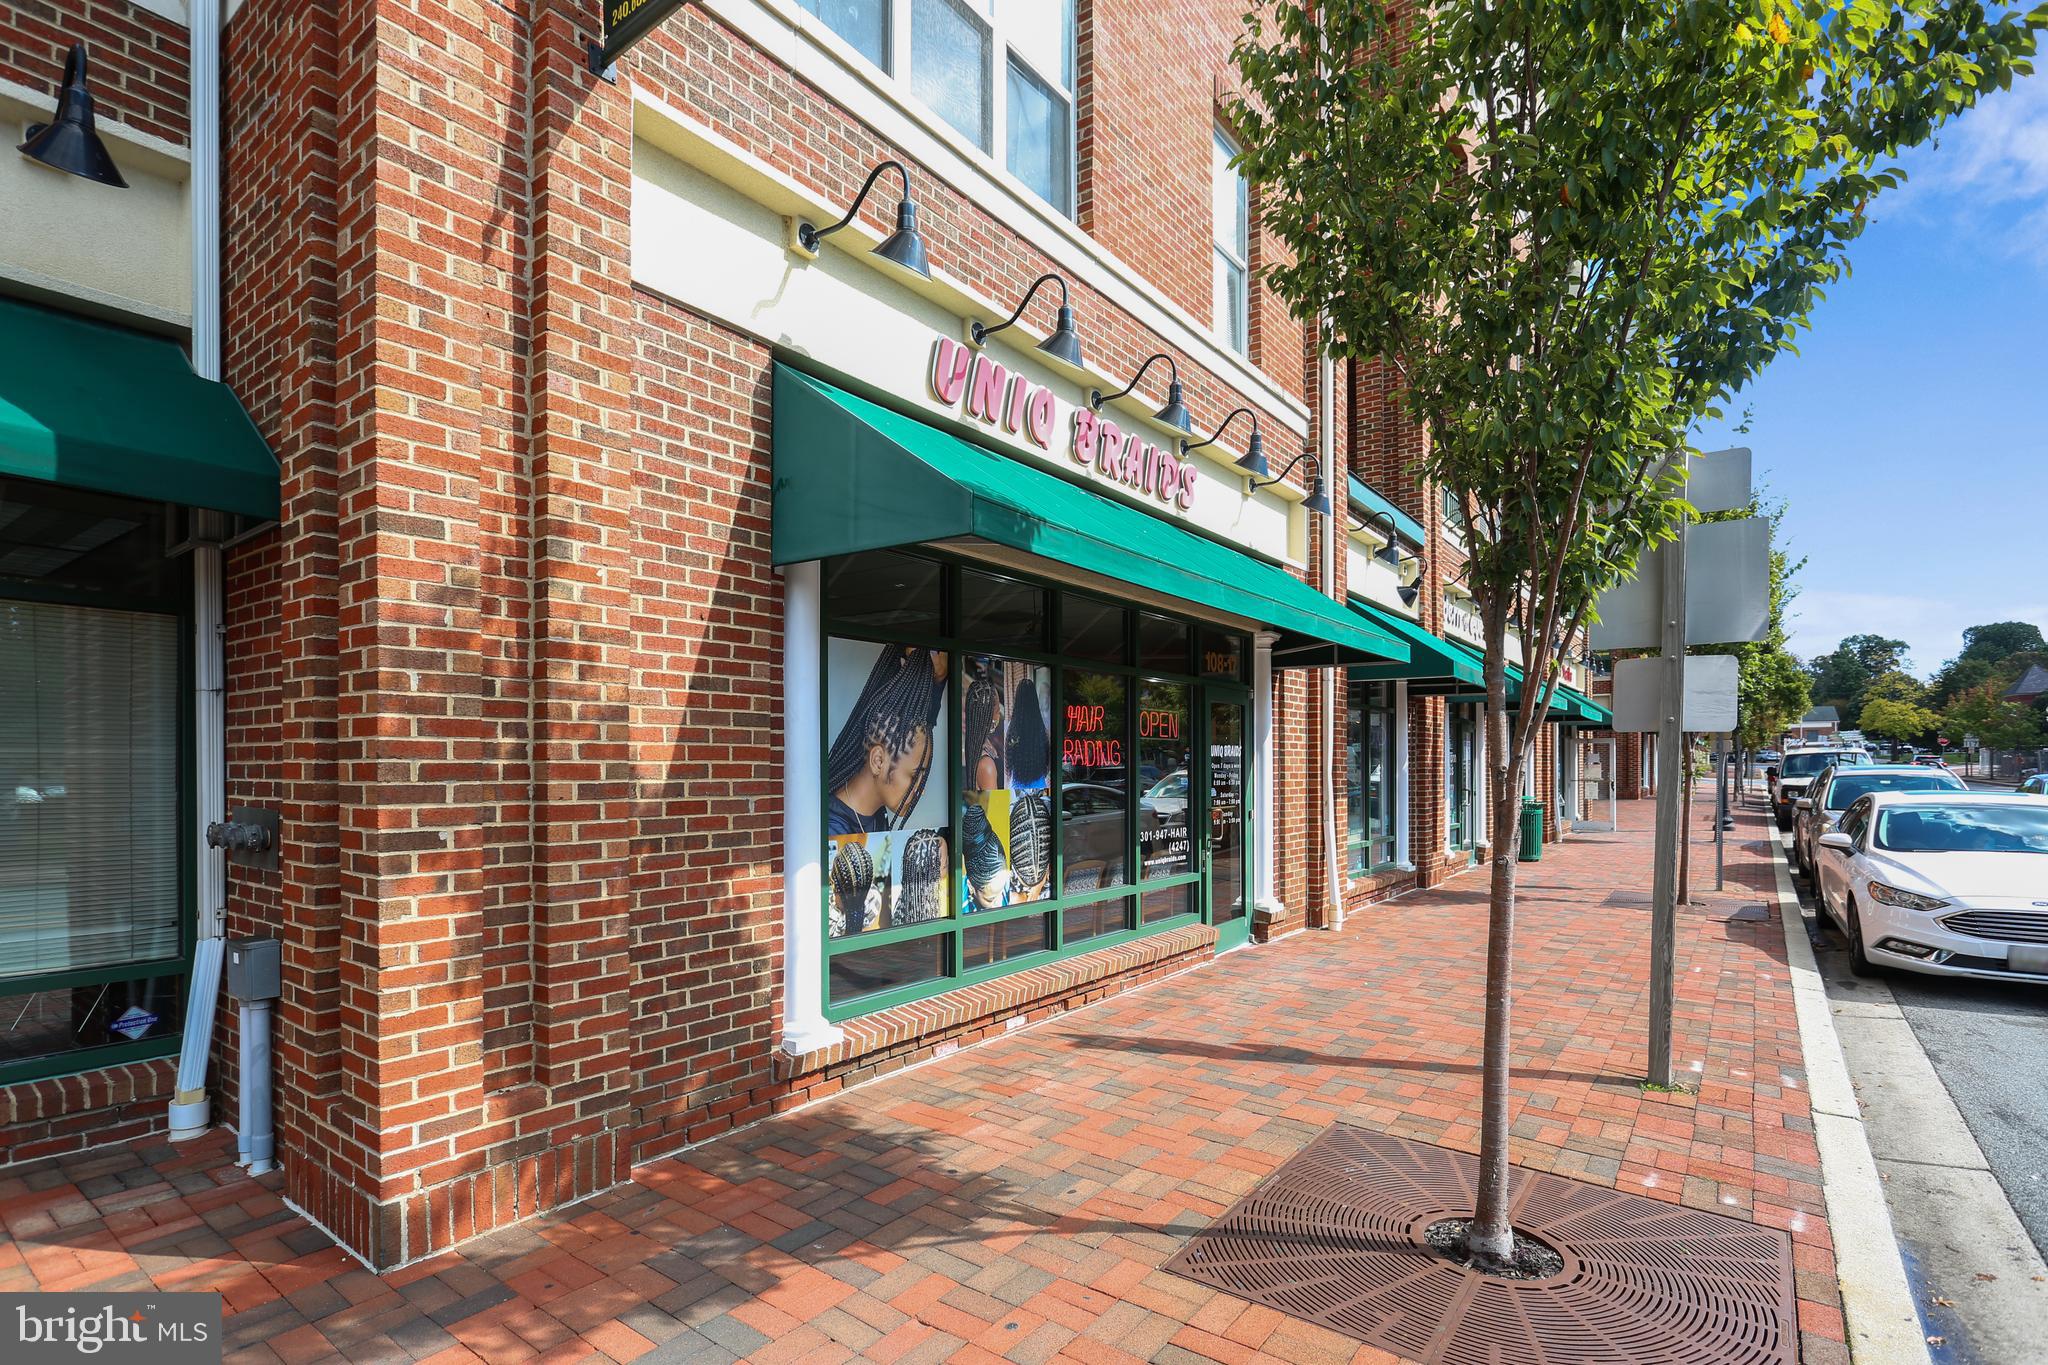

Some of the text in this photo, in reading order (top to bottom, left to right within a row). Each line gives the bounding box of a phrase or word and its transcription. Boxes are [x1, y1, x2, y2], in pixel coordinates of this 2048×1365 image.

[930, 334, 1199, 512] UNIQ BRAIDS
[1067, 705, 1105, 732] HAIR
[1139, 710, 1179, 738] OPEN
[1211, 745, 1242, 757] UNIQ BRAIDS
[1140, 827, 1188, 842] 301-947-HAIR
[1168, 839, 1190, 855] (4247)
[1144, 854, 1187, 866] www.uniqbraids.com
